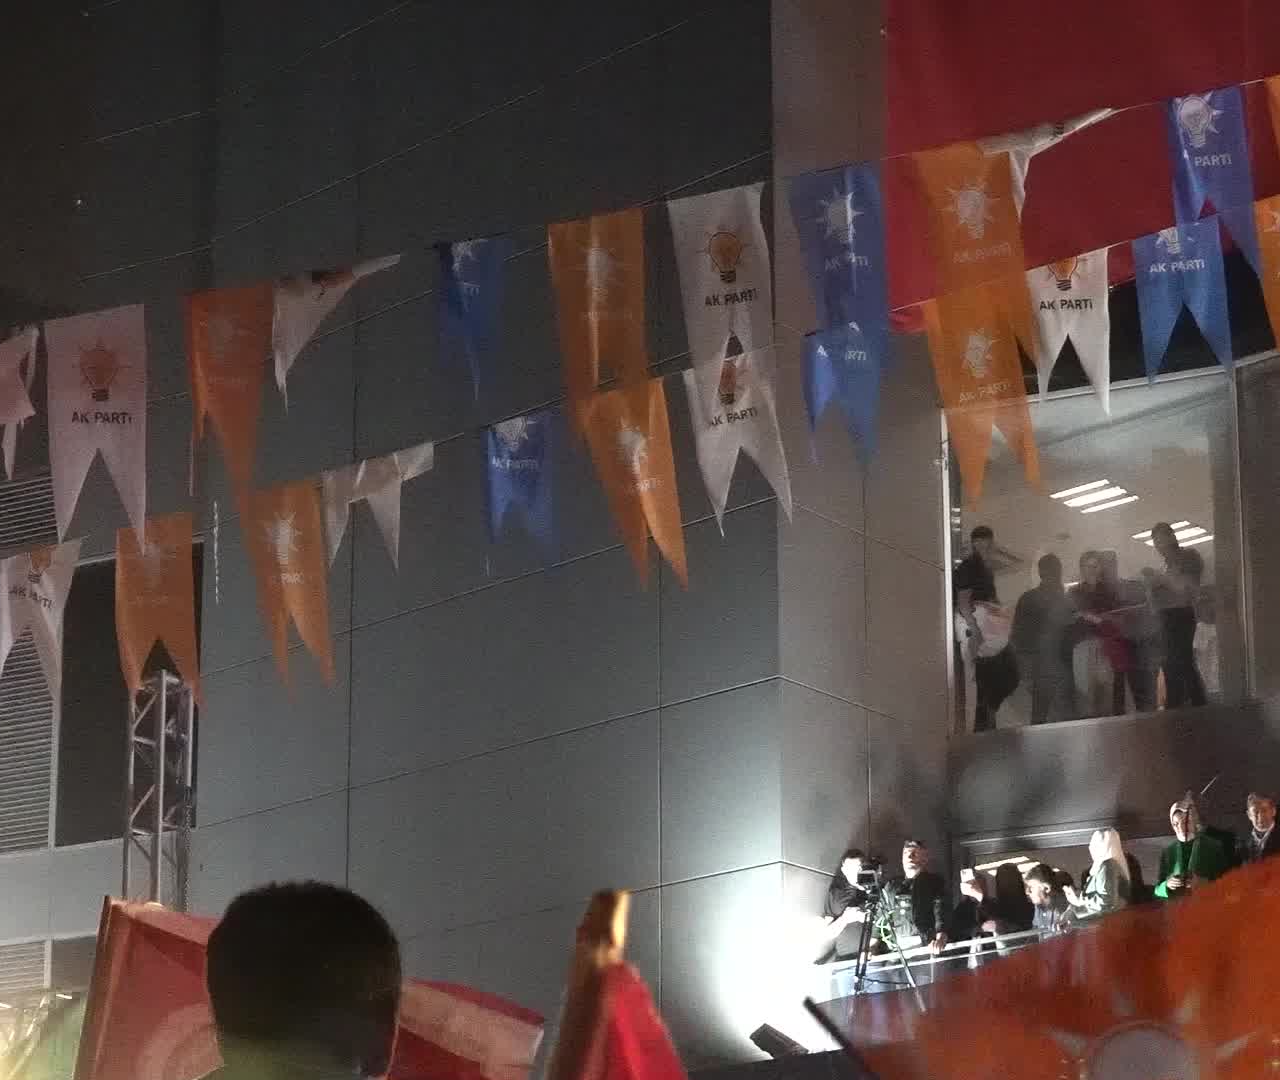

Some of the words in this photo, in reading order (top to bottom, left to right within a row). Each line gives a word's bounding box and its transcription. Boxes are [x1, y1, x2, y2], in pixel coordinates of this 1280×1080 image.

[1149, 260, 1169, 273] AK
[704, 294, 722, 306] AK
[1039, 300, 1057, 312] AK
[71, 411, 90, 424] AK
